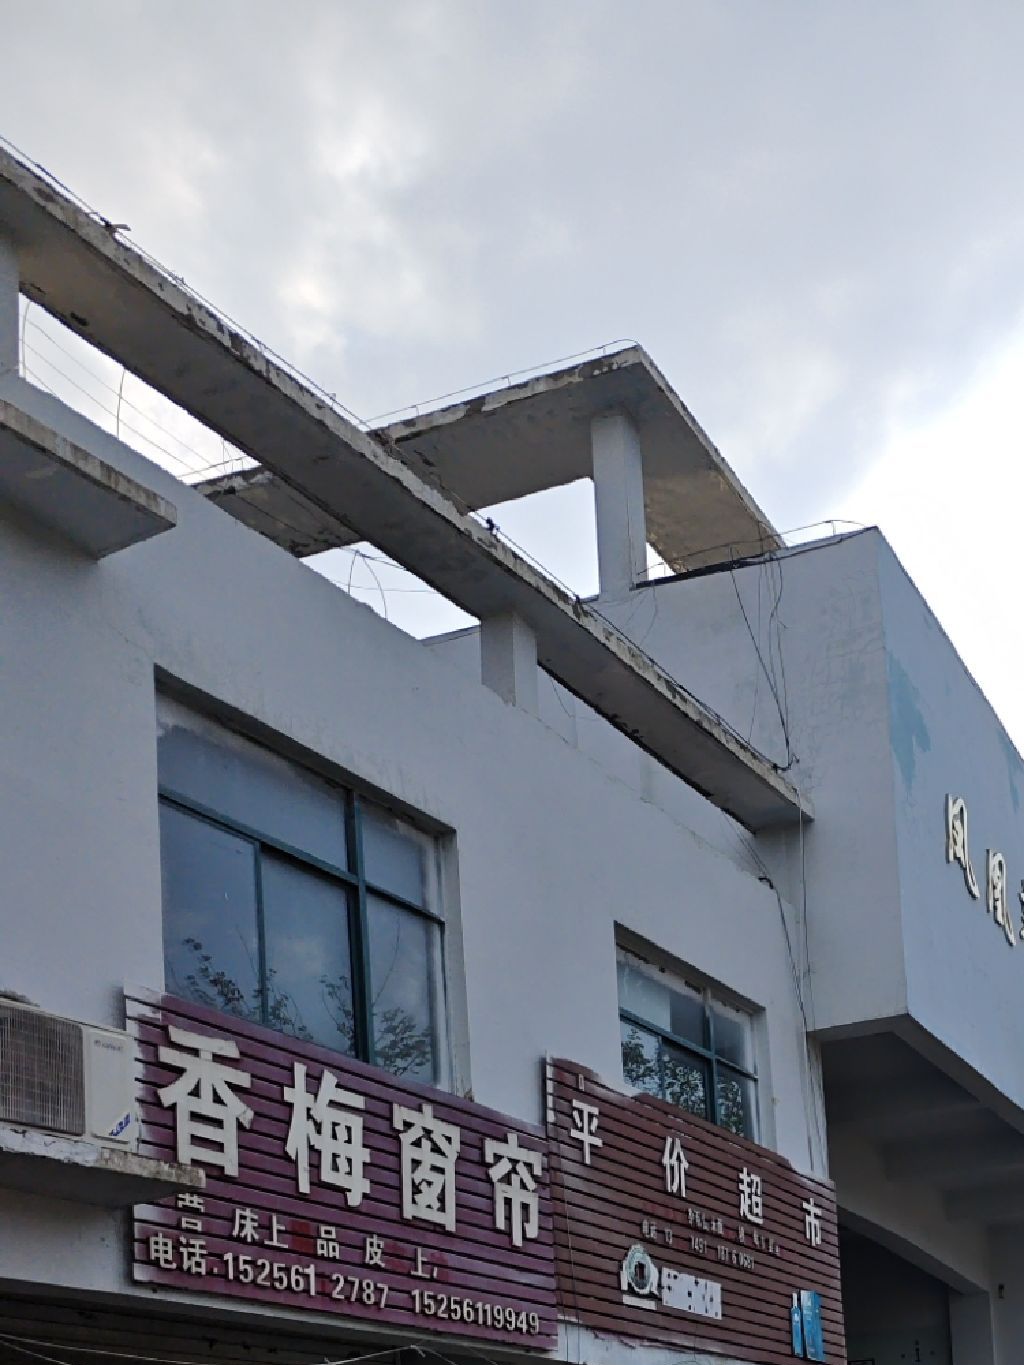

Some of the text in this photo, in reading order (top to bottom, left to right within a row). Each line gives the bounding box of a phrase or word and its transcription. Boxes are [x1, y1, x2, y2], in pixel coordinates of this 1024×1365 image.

[158, 1024, 544, 1248] 香梅窗帘
[569, 1098, 824, 1248] 平价超市
[411, 1289, 540, 1336] 15256119949
